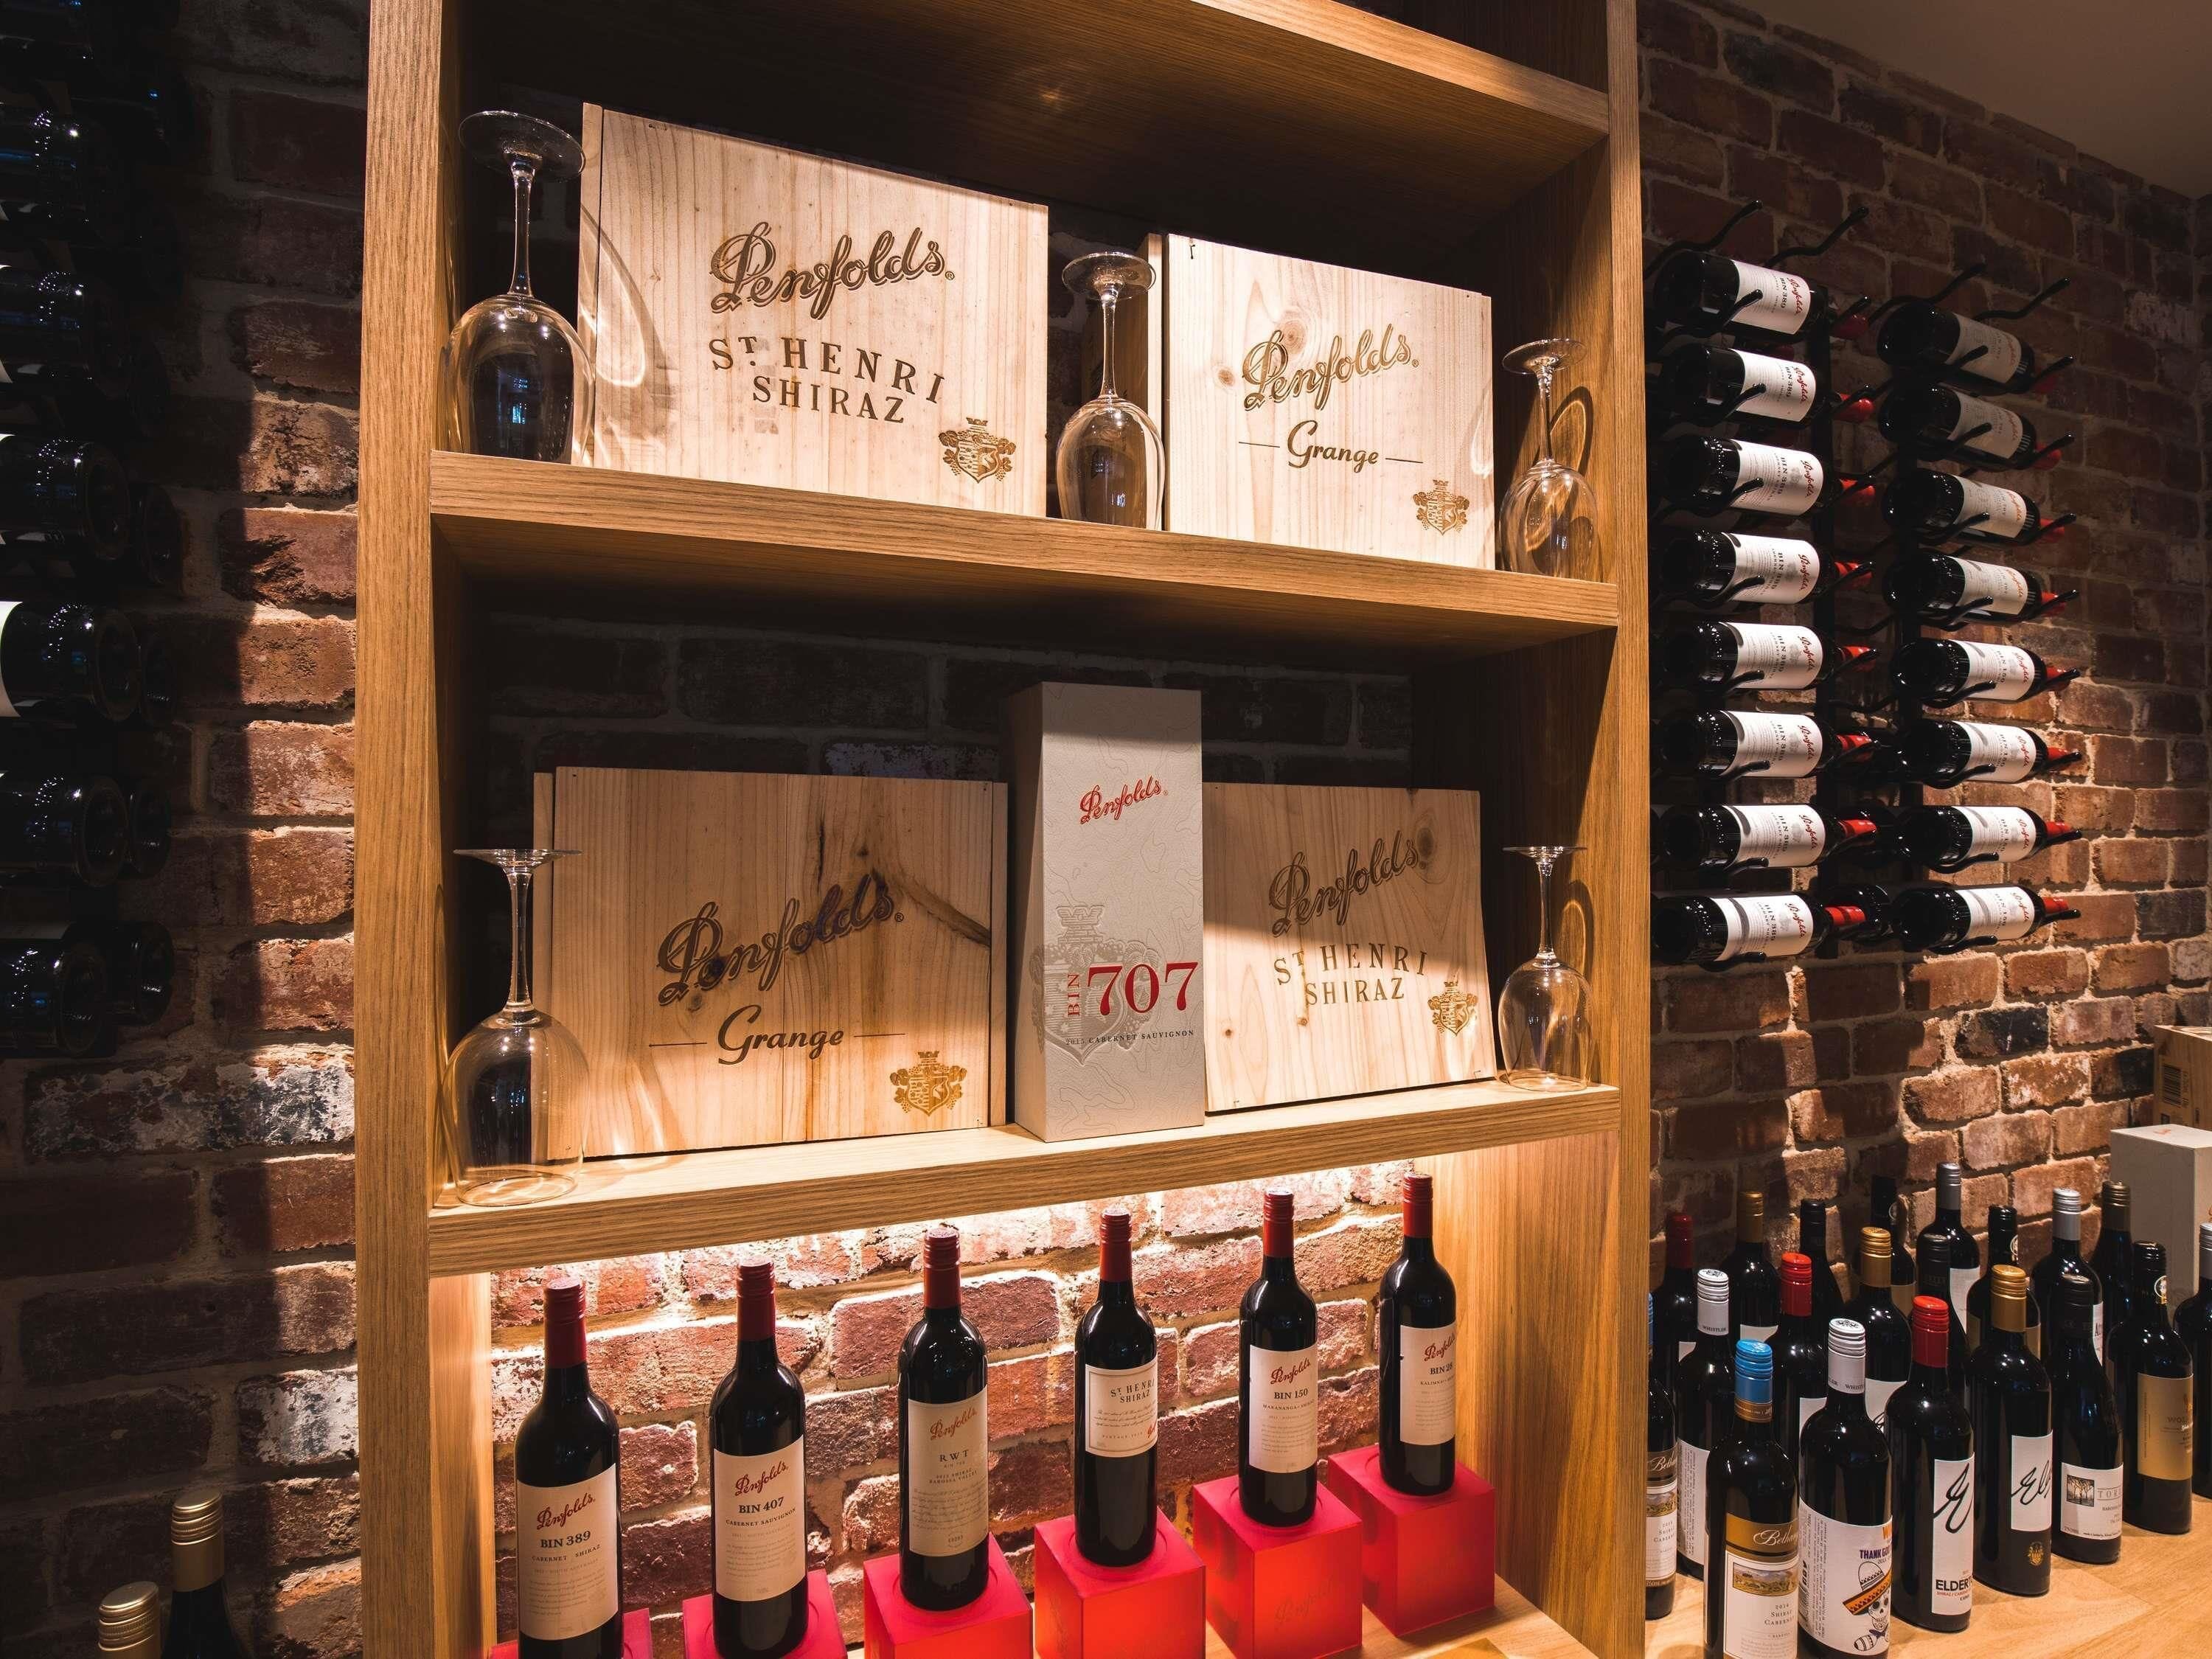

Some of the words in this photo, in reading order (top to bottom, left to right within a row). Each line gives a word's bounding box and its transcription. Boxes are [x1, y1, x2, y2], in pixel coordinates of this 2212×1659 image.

[709, 221, 946, 320] Penfolds
[782, 337, 945, 404] HENRI
[1242, 324, 1411, 411] Penfolds
[754, 376, 905, 424] SHIRAZ
[1287, 420, 1379, 473] Grange
[1080, 775, 1163, 825] Penfolds
[1269, 830, 1419, 937] Penfolds
[656, 872, 894, 1006] Penfolds
[1321, 942, 1427, 975] HENRI
[1068, 973, 1079, 1016] BIN
[1088, 961, 1198, 1016] 707
[1306, 977, 1405, 1005] SHIRAZ
[717, 1005, 844, 1065] Grange
[1088, 1033, 1137, 1044] CABERNET
[1141, 1029, 1194, 1040] SAUVIGNON
[1127, 1379, 1155, 1394] HENRI
[1270, 1357, 1311, 1384] Penfolds
[1430, 1367, 1445, 1375] BIN
[1120, 1389, 1150, 1403] SHIRAZ
[1295, 1388, 1308, 1399] 150
[930, 1408, 977, 1441] Penfolds
[735, 1461, 787, 1497] Penfolds
[537, 1492, 594, 1531] Penfolds
[739, 1504, 761, 1514] BIN
[763, 1497, 785, 1510] 407
[761, 1507, 796, 1525] SAUVIGNON
[540, 1539, 564, 1548] BIN
[566, 1531, 591, 1546] 389
[575, 1545, 602, 1558] SHIRAZ
[1859, 1547, 1881, 1559] THANK
